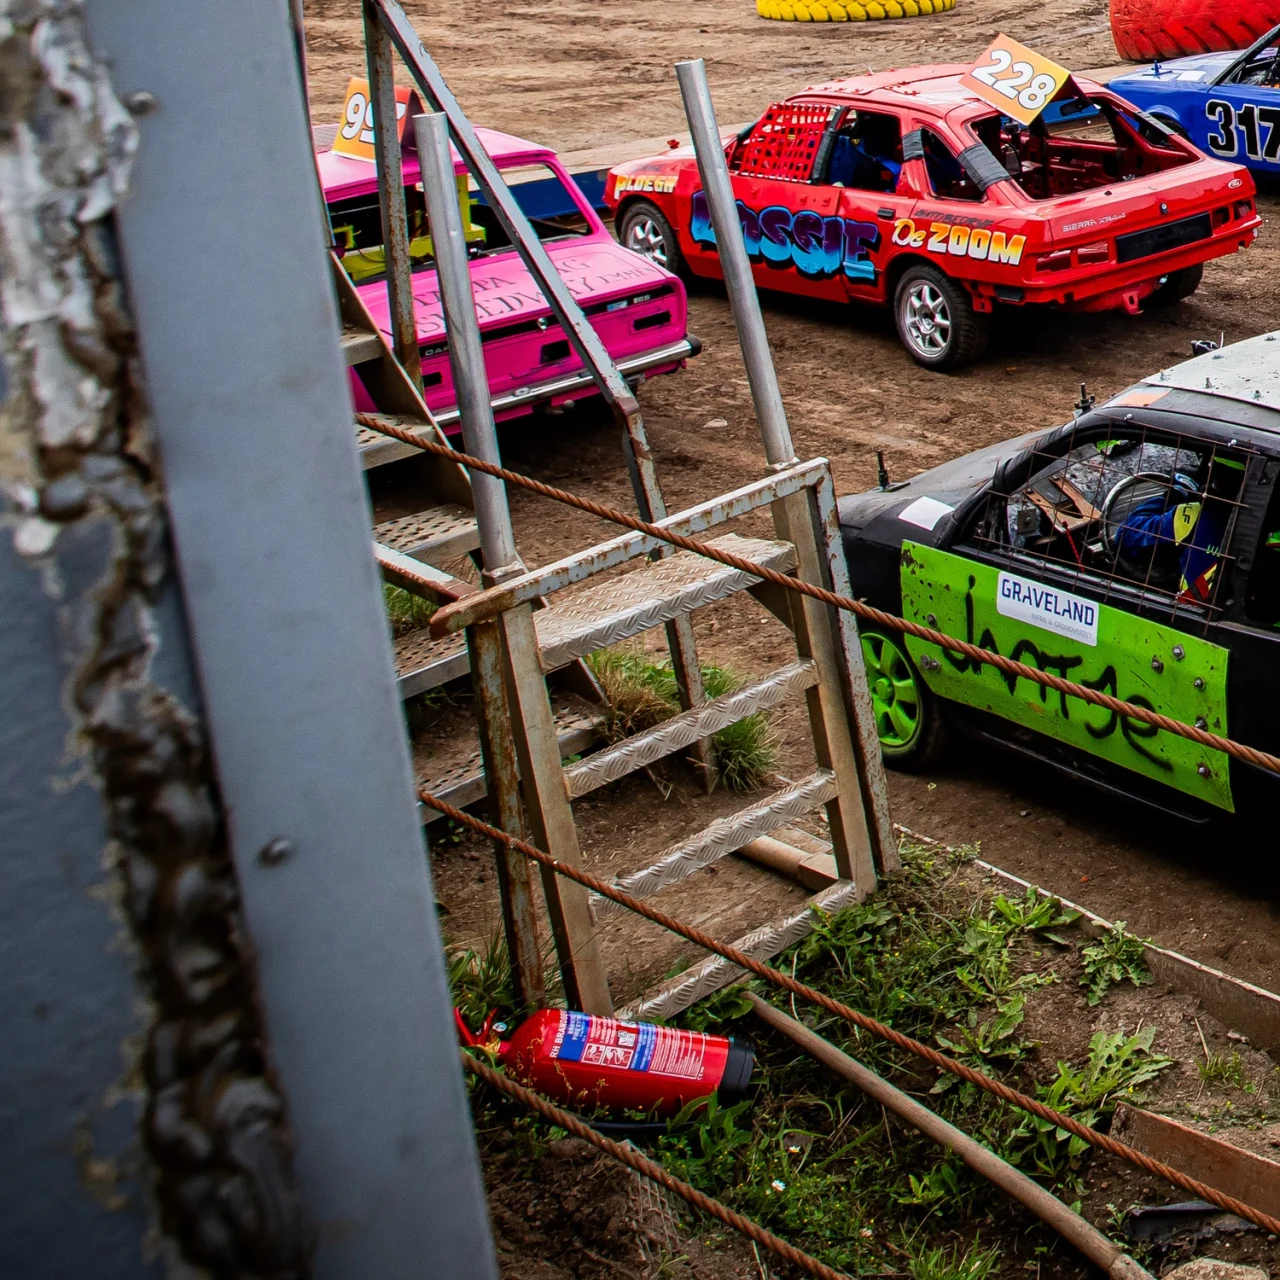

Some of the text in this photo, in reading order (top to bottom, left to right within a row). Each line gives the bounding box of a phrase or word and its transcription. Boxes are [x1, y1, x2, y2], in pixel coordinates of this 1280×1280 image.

[970, 48, 1057, 110] 228
[926, 222, 1028, 266] ZOOM
[1062, 219, 1098, 233] SIERRA
[1001, 578, 1095, 627] GRAVELAND
